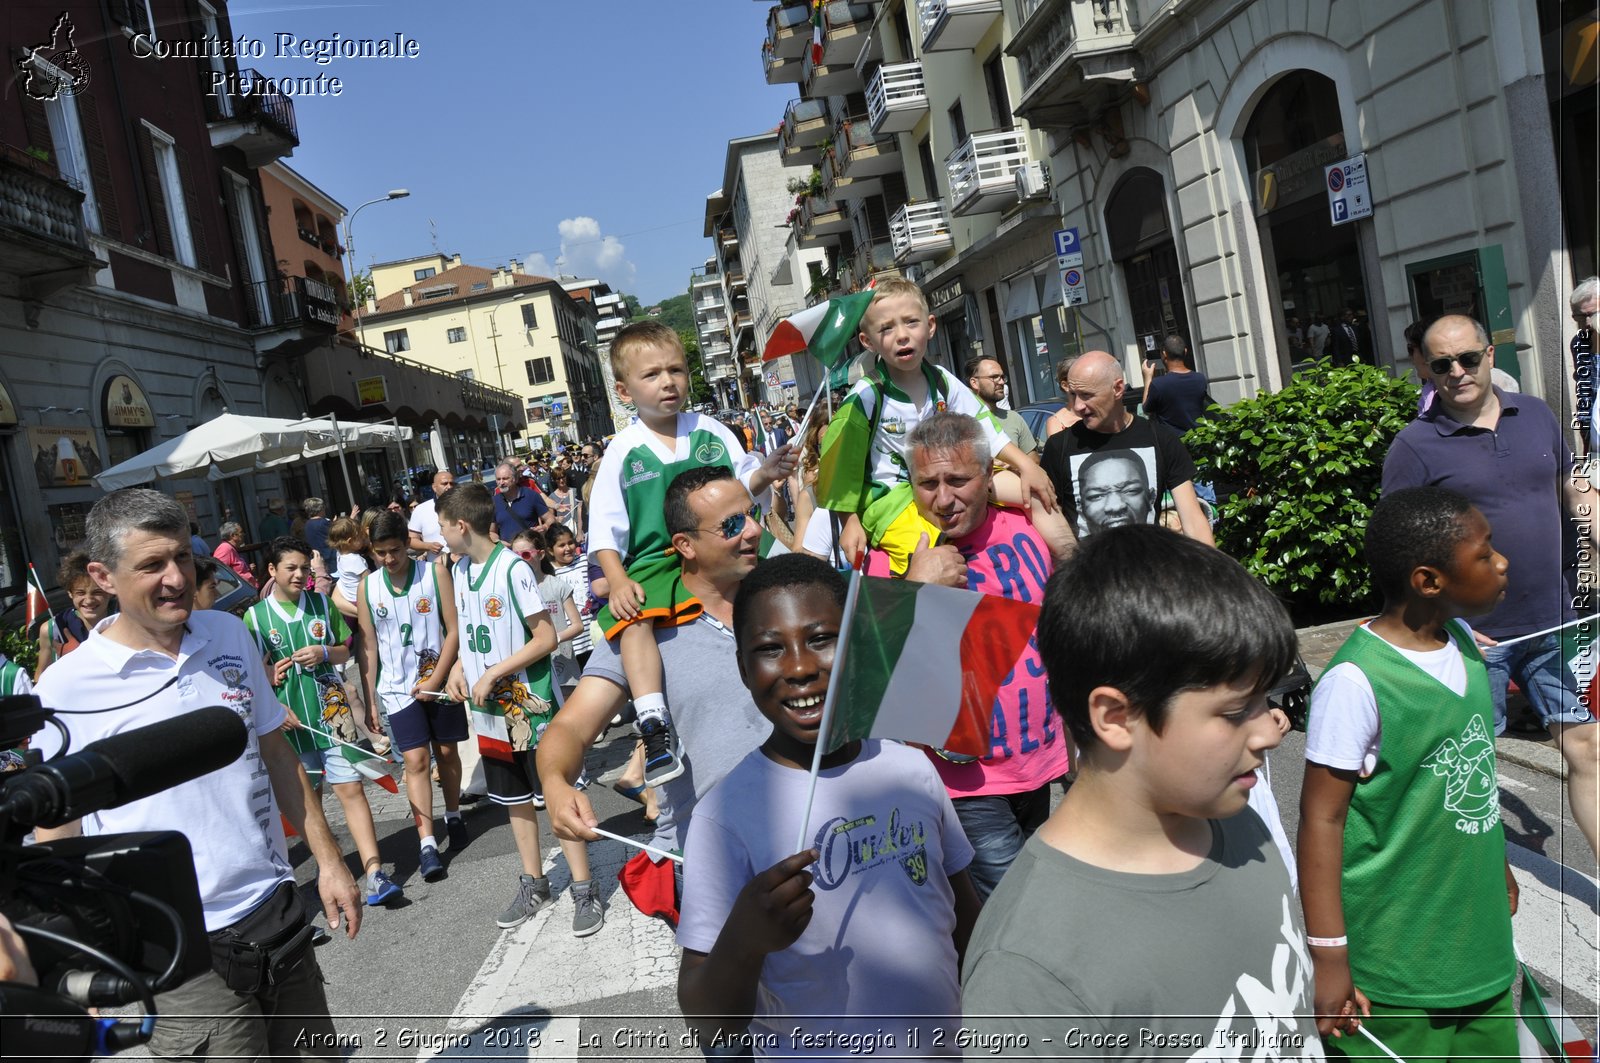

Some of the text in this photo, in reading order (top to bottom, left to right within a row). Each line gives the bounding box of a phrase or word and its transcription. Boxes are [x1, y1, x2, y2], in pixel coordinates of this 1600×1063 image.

[1335, 202, 1345, 219] P
[1058, 231, 1075, 254] P
[114, 405, 145, 417] JIMMY'S
[401, 623, 412, 647] 2
[466, 623, 492, 654] 36
[1455, 818, 1479, 834] CMB
[907, 855, 926, 881] 39
